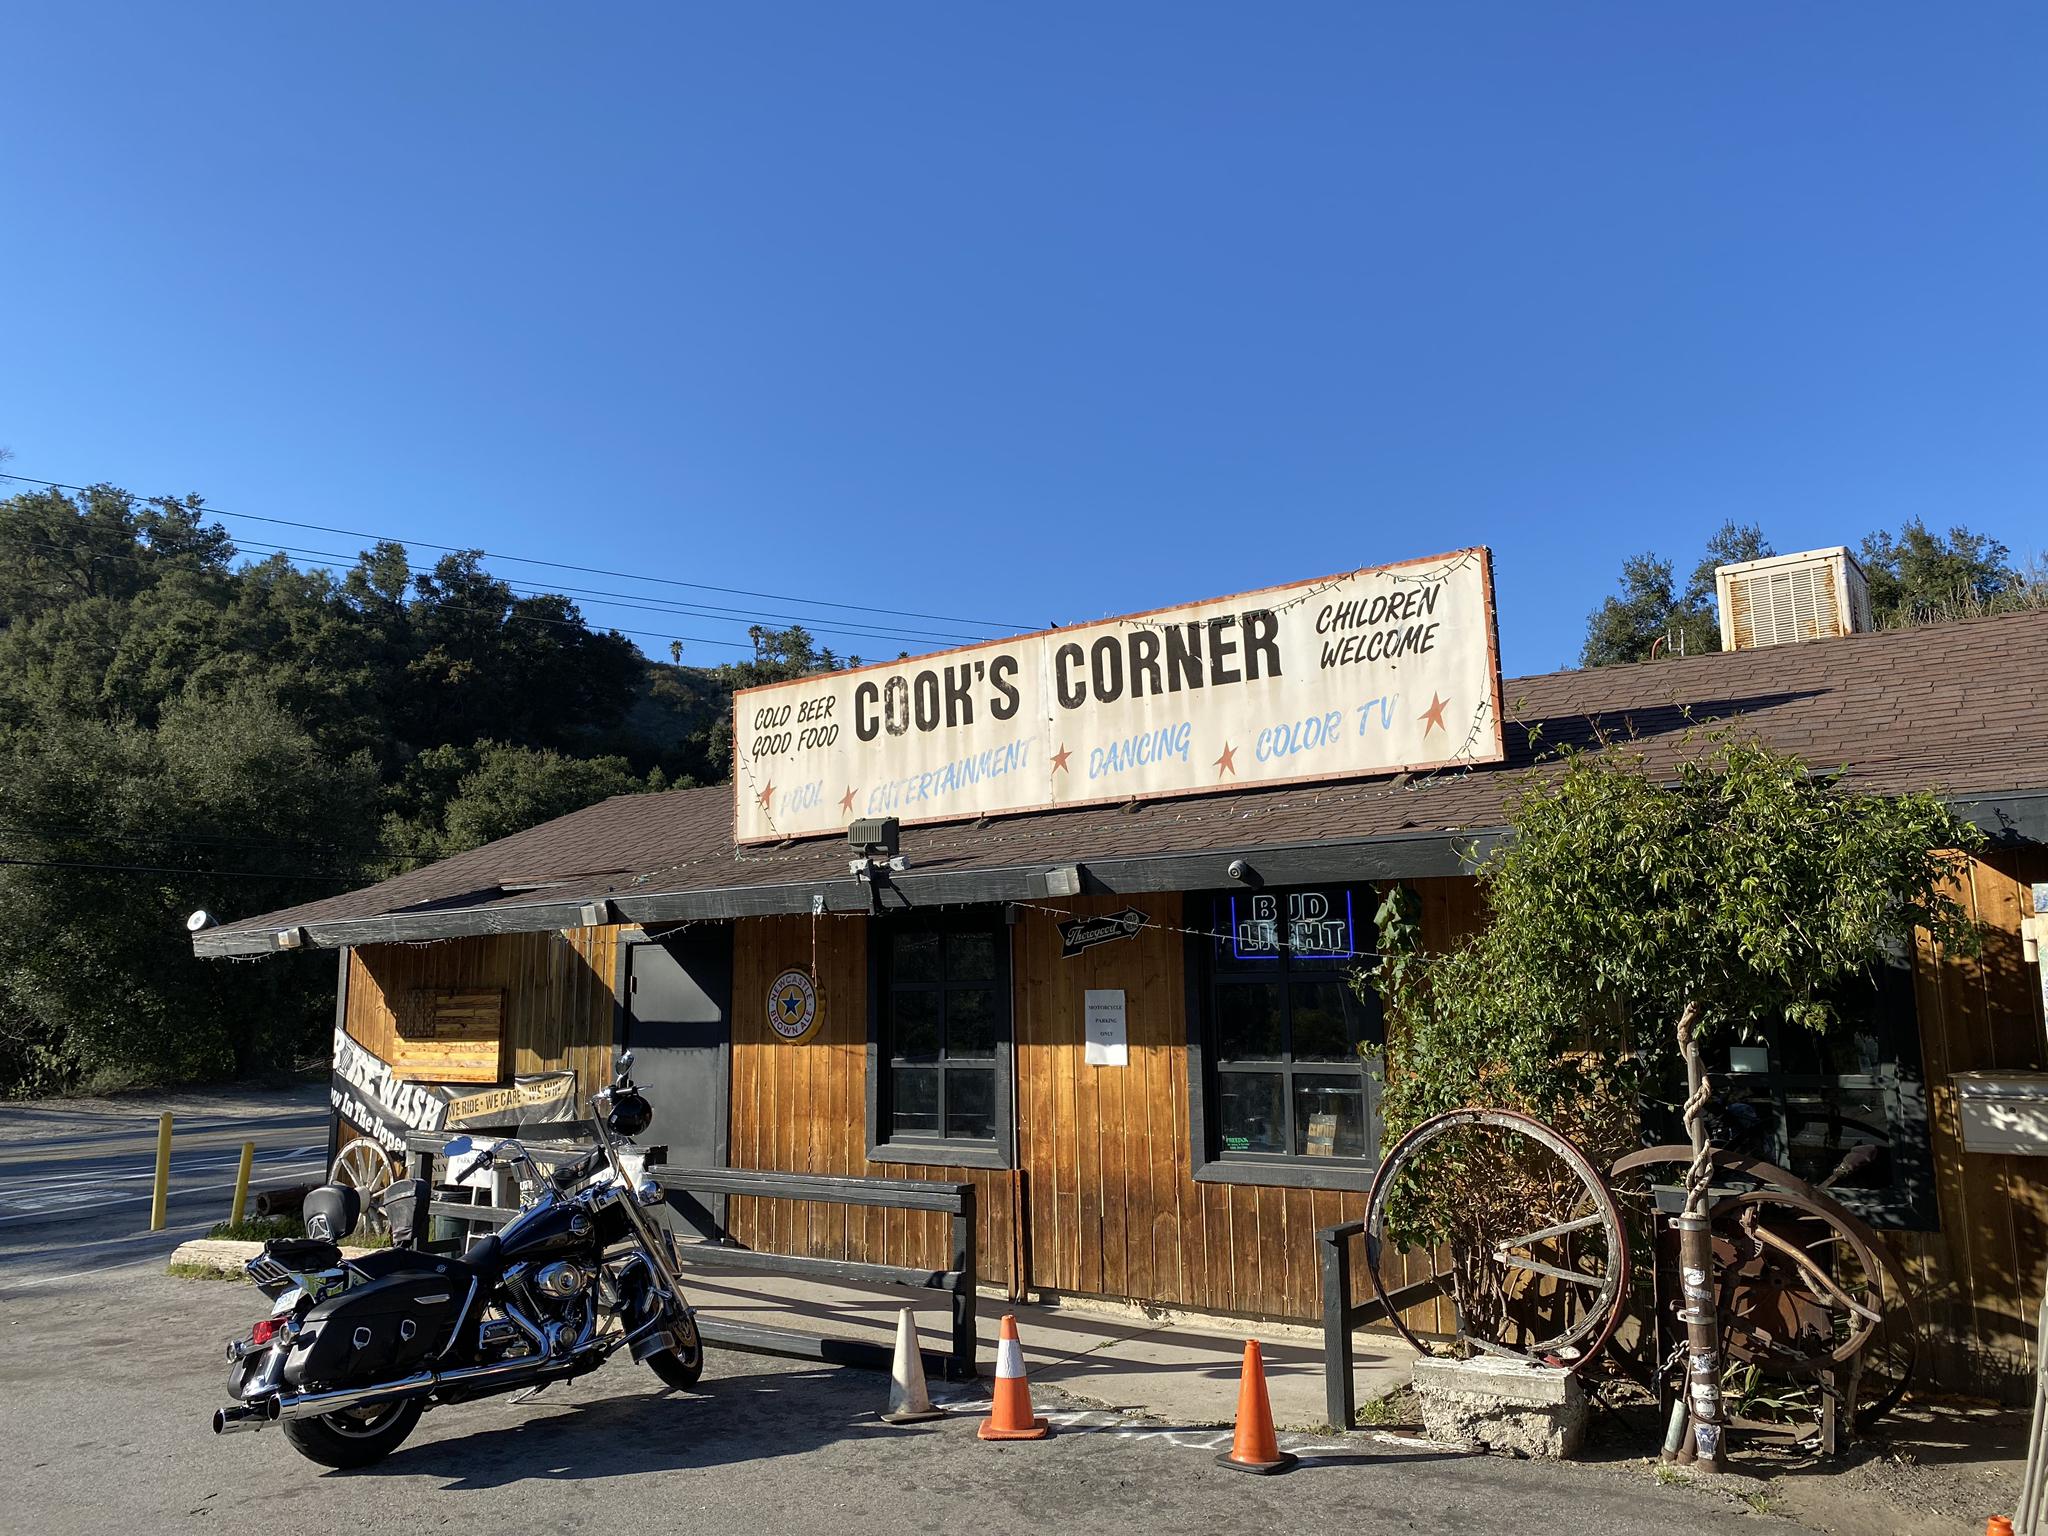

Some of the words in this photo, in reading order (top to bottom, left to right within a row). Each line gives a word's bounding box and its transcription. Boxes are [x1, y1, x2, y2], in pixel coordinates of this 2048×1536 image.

[1315, 583, 1441, 635] CHILDREN
[1320, 622, 1441, 670] WELCOME
[854, 654, 1020, 742] COOK'S
[1054, 608, 1283, 710] CORNER
[754, 704, 792, 731] COLD
[797, 695, 837, 724] BEER
[751, 731, 793, 764] GOOD
[797, 723, 840, 752] FOOD
[779, 779, 824, 817] POOL
[867, 736, 1037, 816] ENTERTAINMENT
[1088, 721, 1192, 780] DANCING
[1255, 710, 1343, 764] COLOR
[1356, 693, 1400, 737] TV
[1065, 921, 1119, 947] Thorogood
[771, 975, 813, 1002] NEWCASTLE
[770, 1009, 799, 1035] BROWN
[800, 1010, 813, 1030] ALE
[341, 1091, 354, 1119] In
[352, 1099, 373, 1132] The
[379, 1064, 444, 1131] WASH
[461, 1099, 479, 1116] RIDE
[485, 1093, 499, 1110] WE
[500, 1088, 521, 1107] CARE
